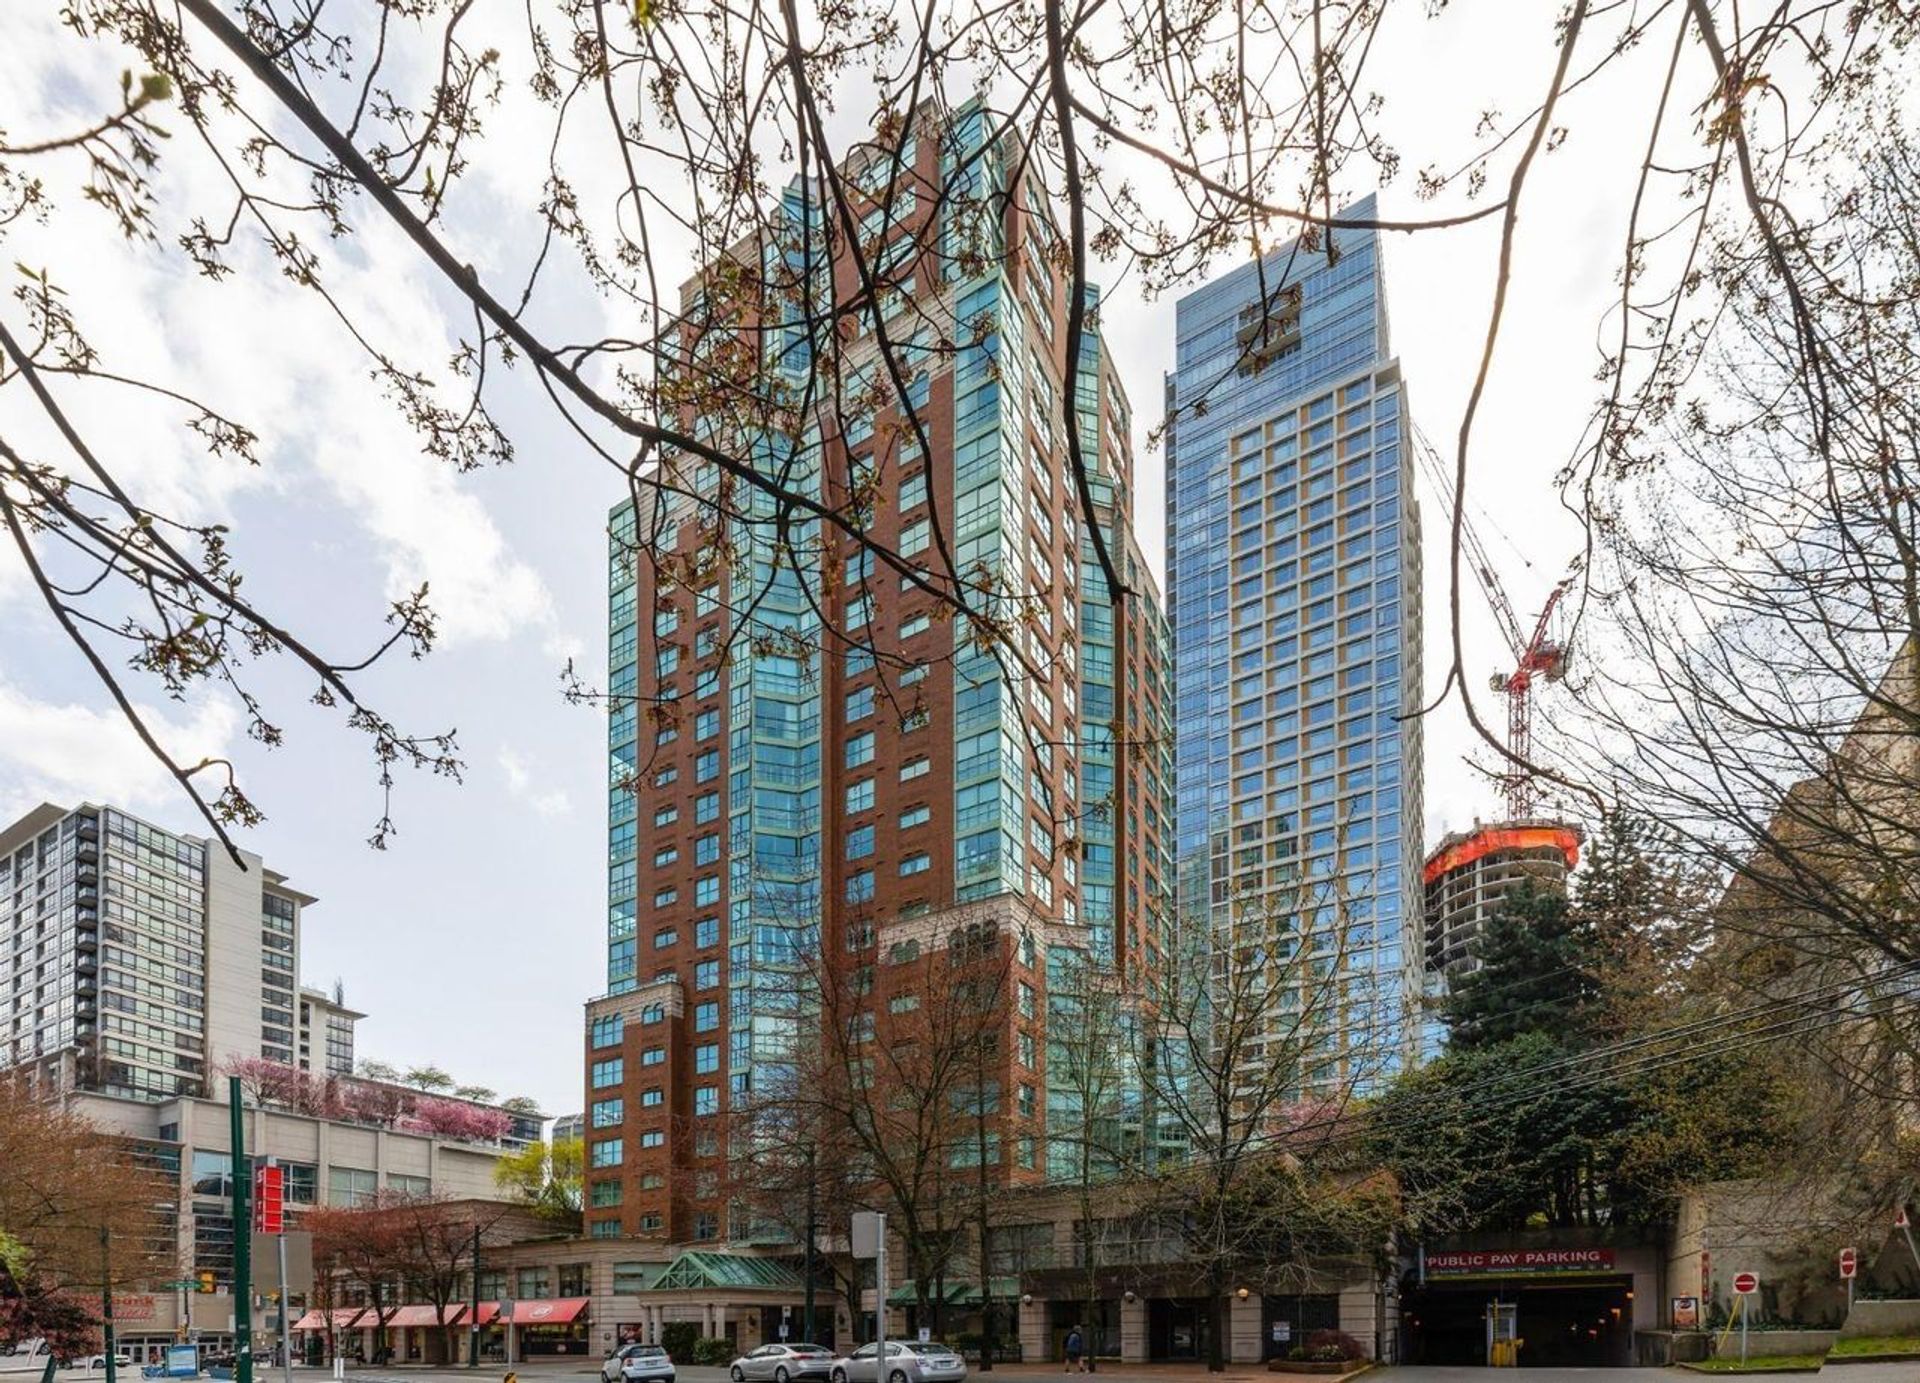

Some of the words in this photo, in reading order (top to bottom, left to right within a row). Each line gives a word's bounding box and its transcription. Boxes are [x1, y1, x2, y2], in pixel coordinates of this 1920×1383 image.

[1427, 1255, 1484, 1267] PUBLIC
[1491, 1254, 1519, 1265] PAY
[1525, 1251, 1601, 1264] PARKING
